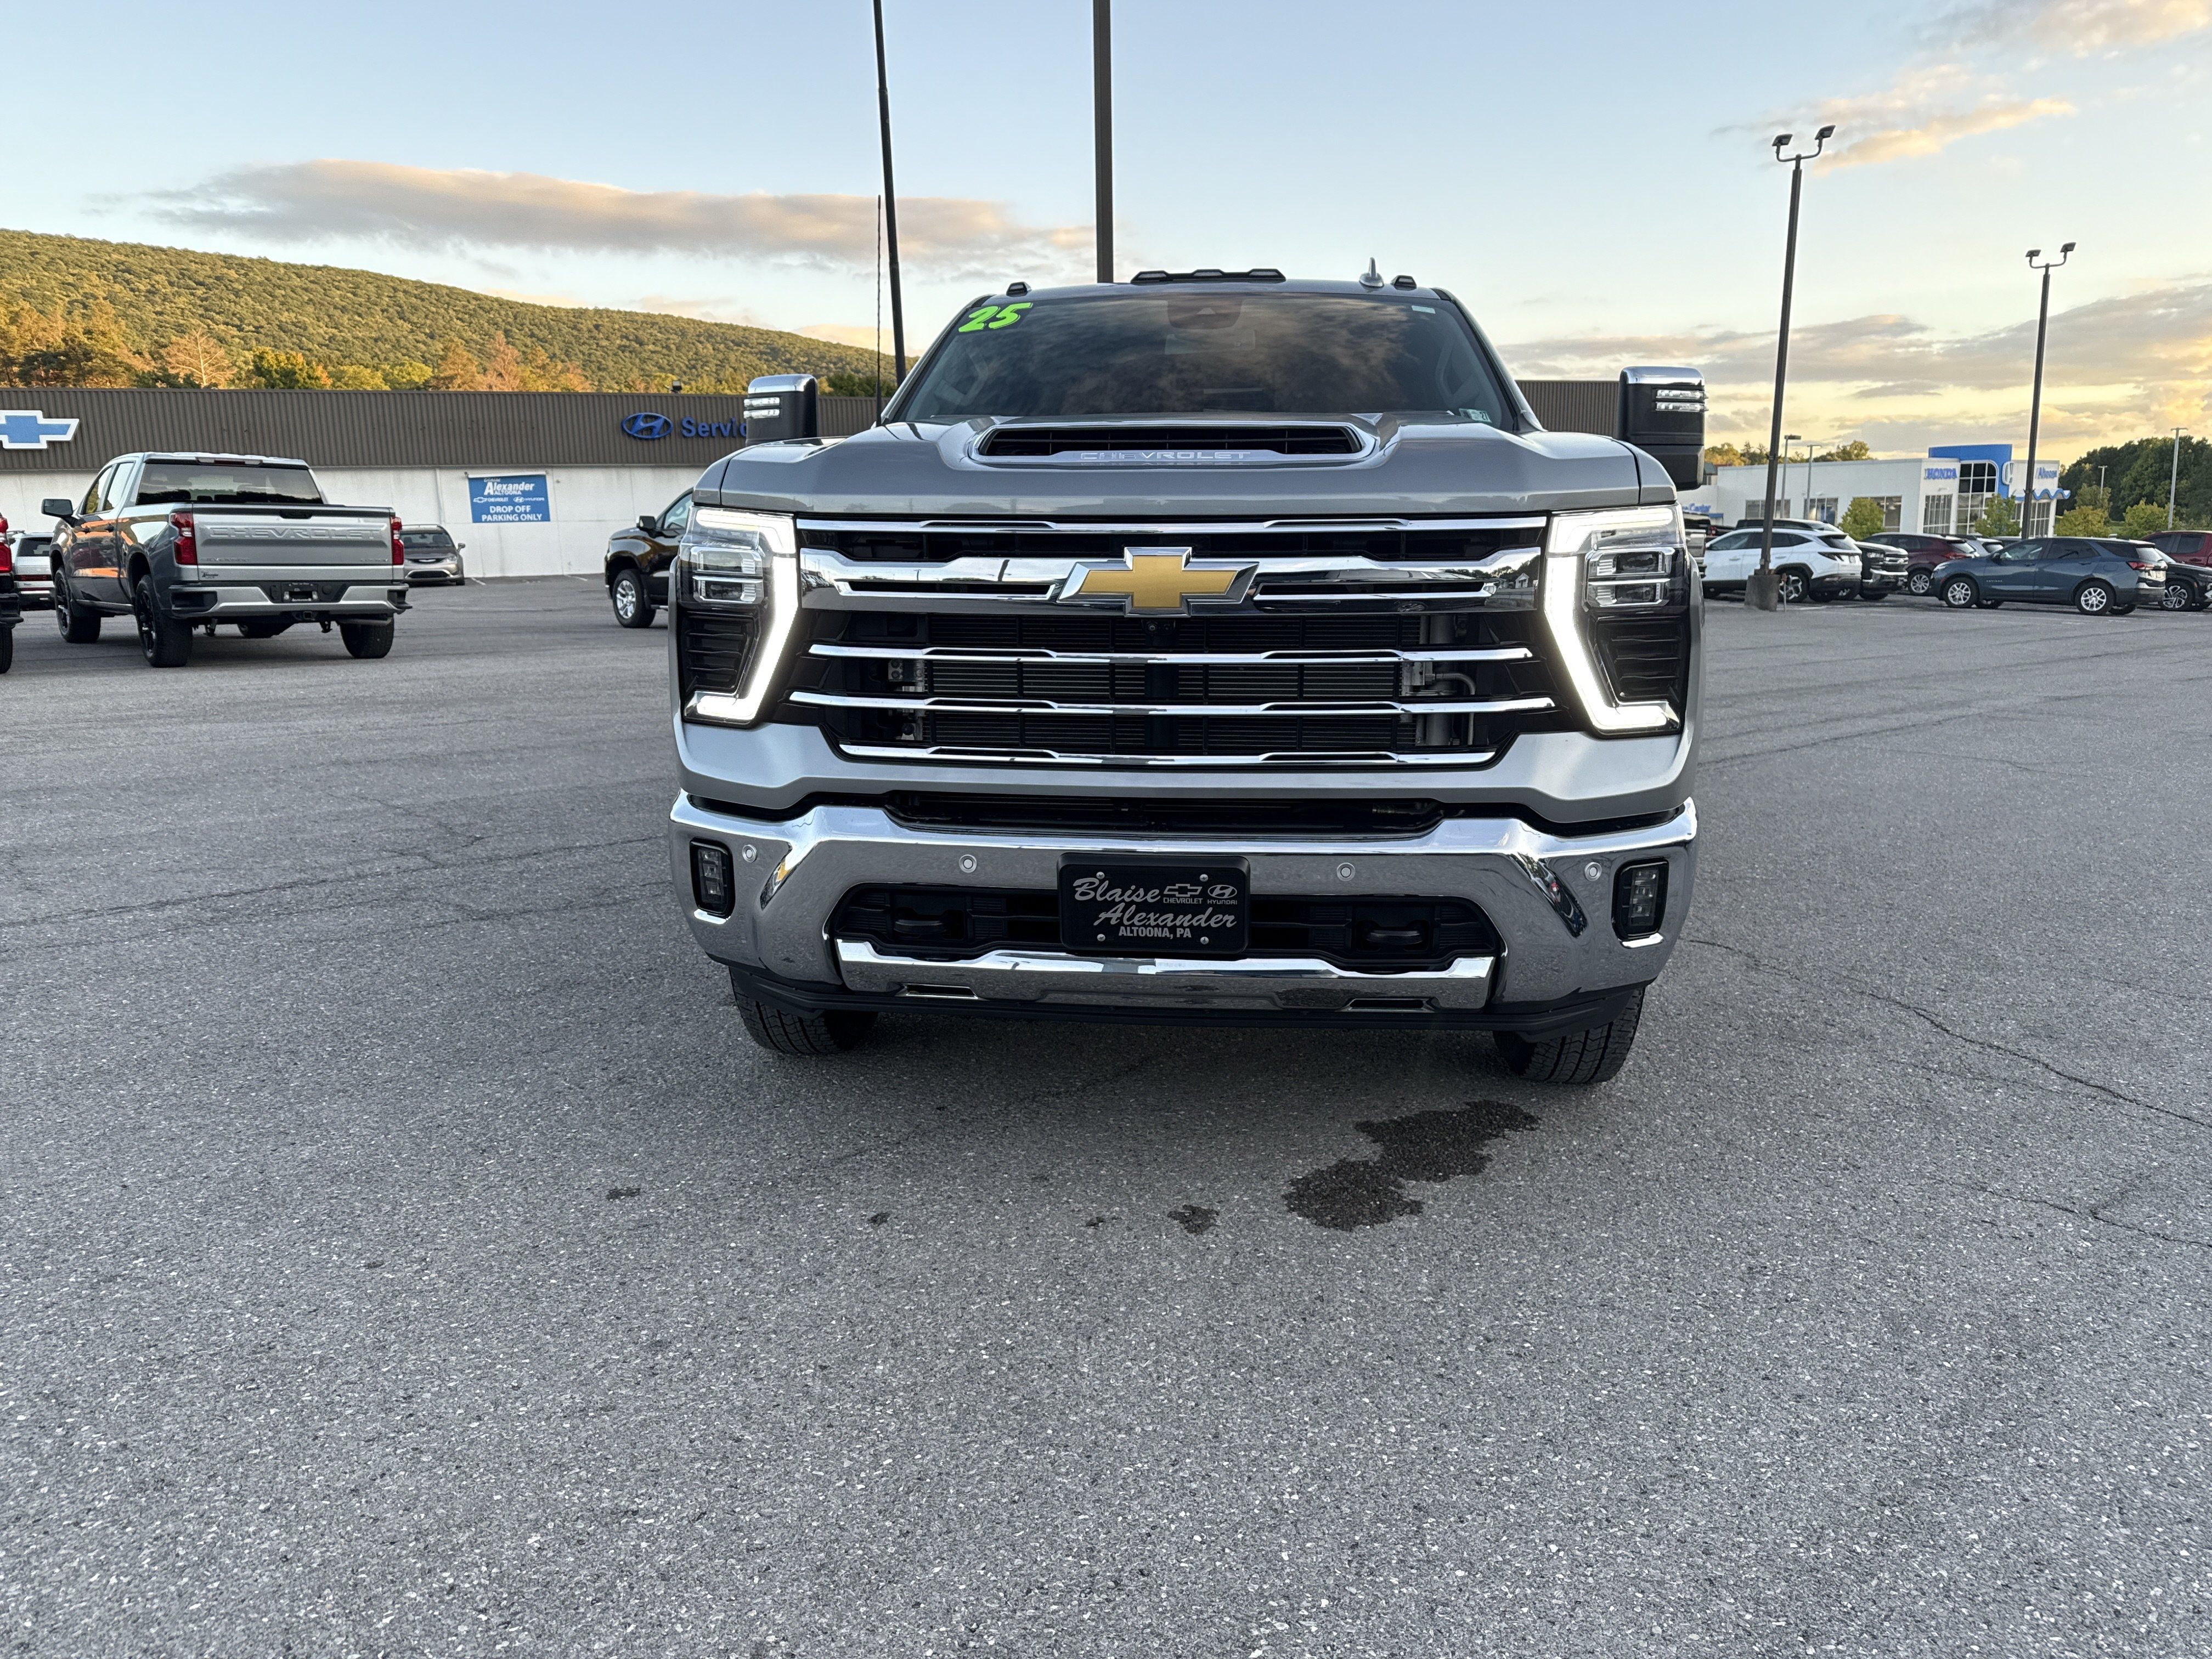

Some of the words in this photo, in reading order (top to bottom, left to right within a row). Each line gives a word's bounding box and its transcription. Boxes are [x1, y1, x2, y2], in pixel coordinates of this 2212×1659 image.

[958, 302, 1034, 332] 25
[681, 416, 747, 438] Servic
[1080, 452, 1251, 460] CHEVROLET
[1924, 468, 1957, 479] HONDA
[483, 482, 535, 495] Alexander
[489, 505, 514, 514] DROP
[515, 505, 531, 513] OFF
[210, 527, 381, 539] CHEVROLET
[1073, 878, 1161, 902] Blaise
[1093, 902, 1237, 928] Alexander
[1118, 926, 1173, 939] ALTOONA,
[1176, 927, 1192, 938] PA
